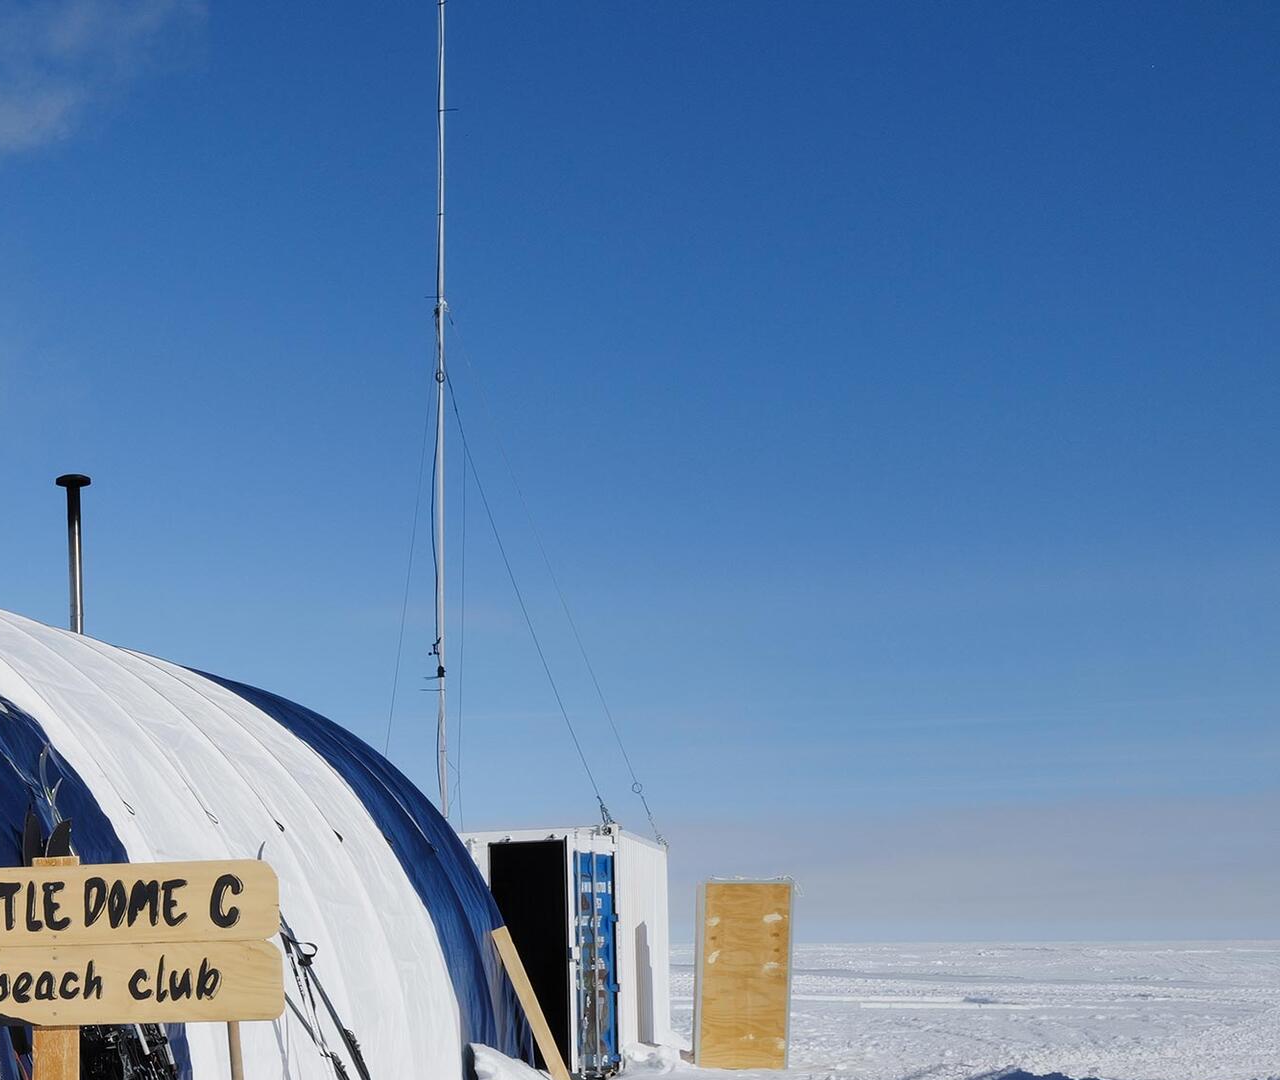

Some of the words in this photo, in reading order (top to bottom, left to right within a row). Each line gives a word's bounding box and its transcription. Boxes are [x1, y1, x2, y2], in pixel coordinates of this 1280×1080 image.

[83, 876, 188, 930] DOME
[209, 873, 244, 929] C
[127, 954, 223, 1003] club
